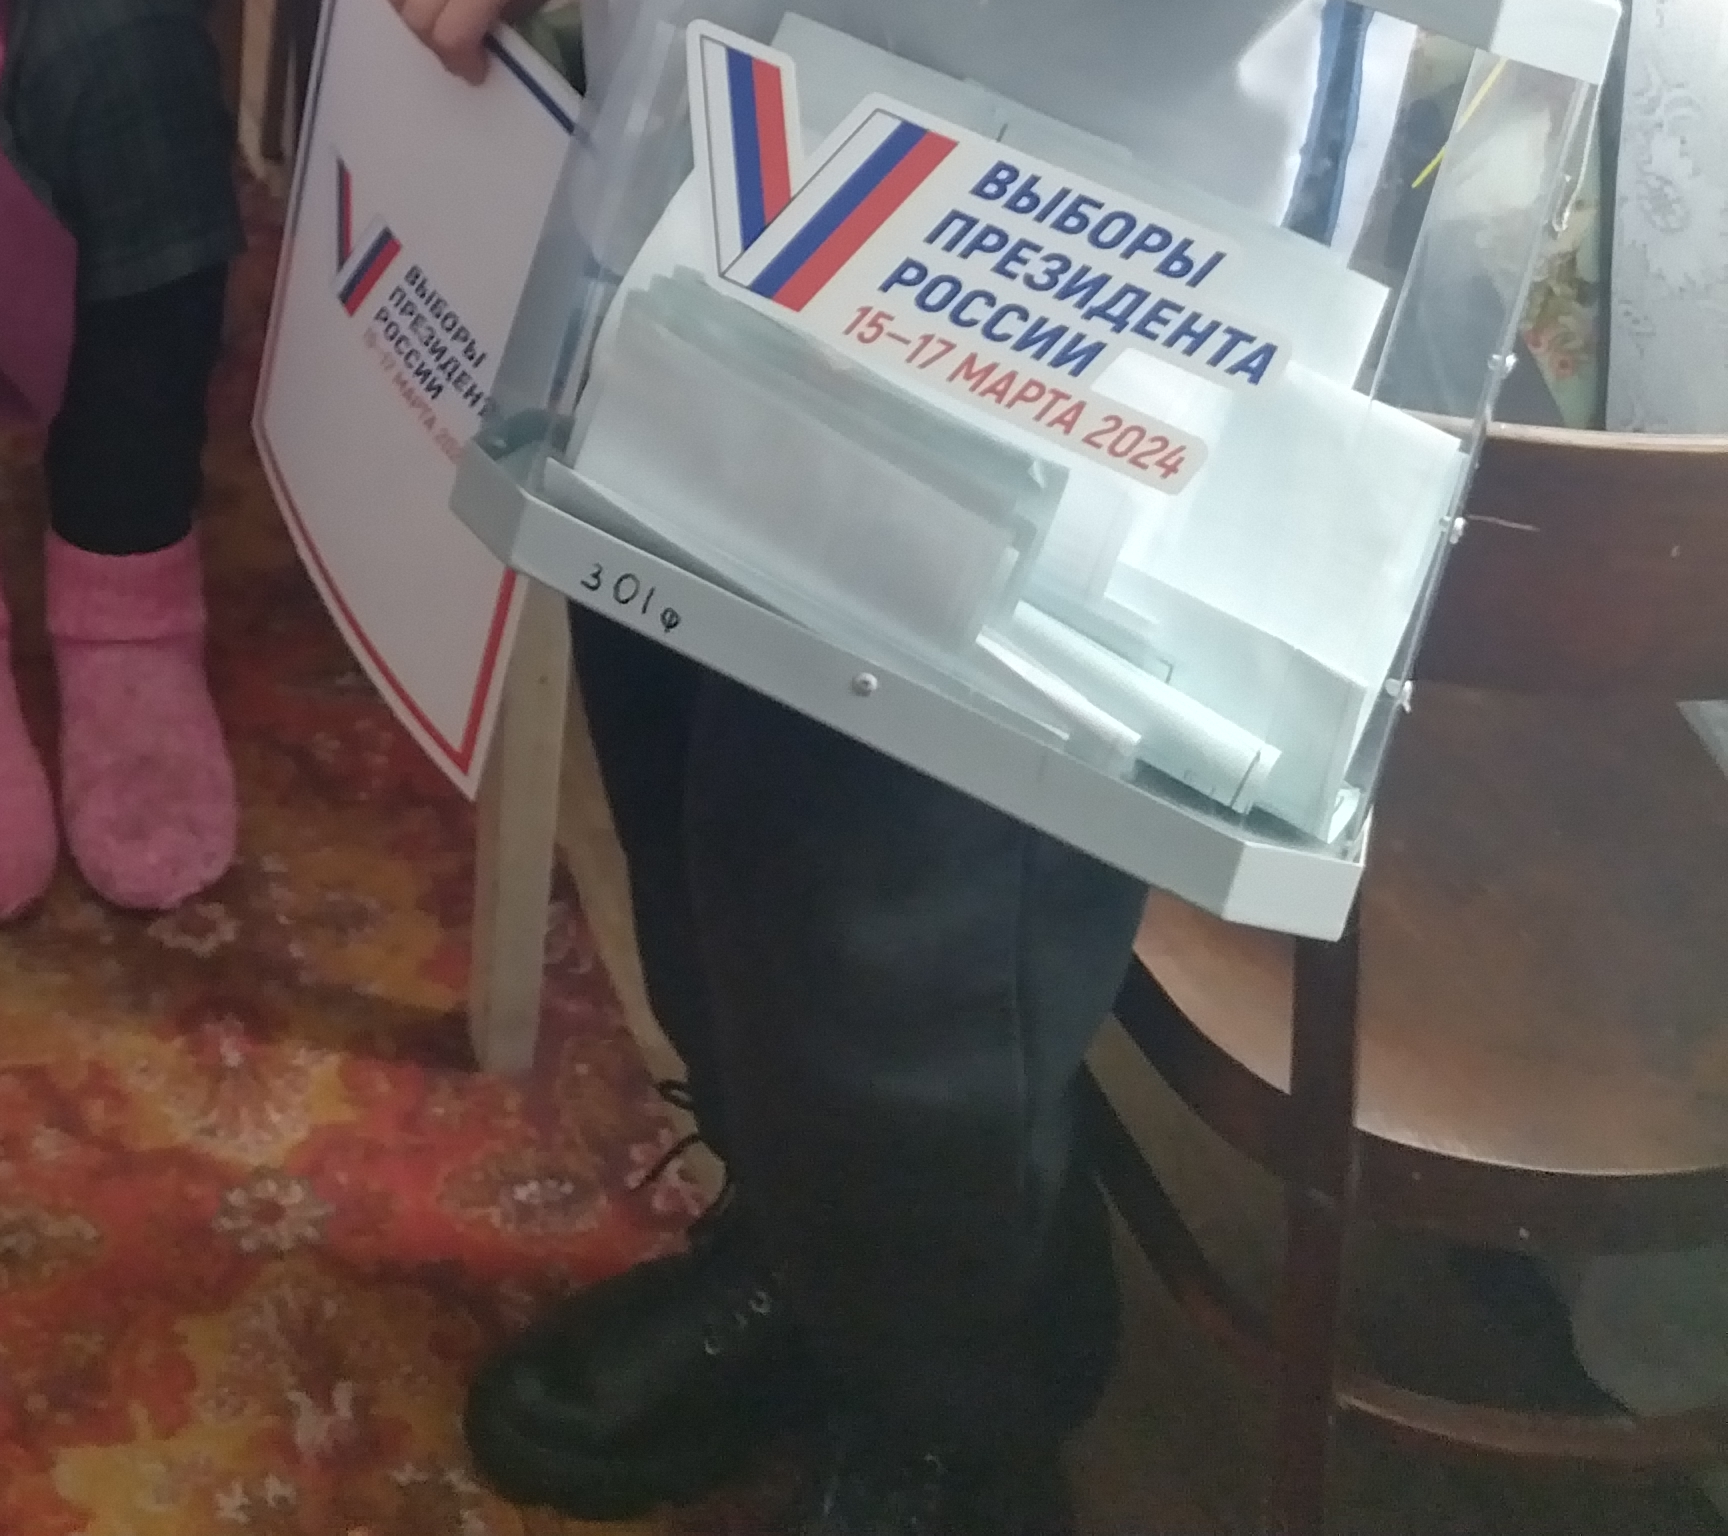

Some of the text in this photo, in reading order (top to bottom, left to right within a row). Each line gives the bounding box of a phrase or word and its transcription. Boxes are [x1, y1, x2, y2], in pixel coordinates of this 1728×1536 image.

[970, 159, 1228, 288] ВЫБОРЫ
[373, 305, 444, 401] РОССИИ
[404, 264, 488, 369] ВЫБОРЫ
[878, 258, 1108, 377] РОССИИ
[924, 208, 1279, 386] ПРЕЗИДЕНТА
[952, 355, 1088, 434] МАРТА
[1082, 414, 1190, 481] 2024
